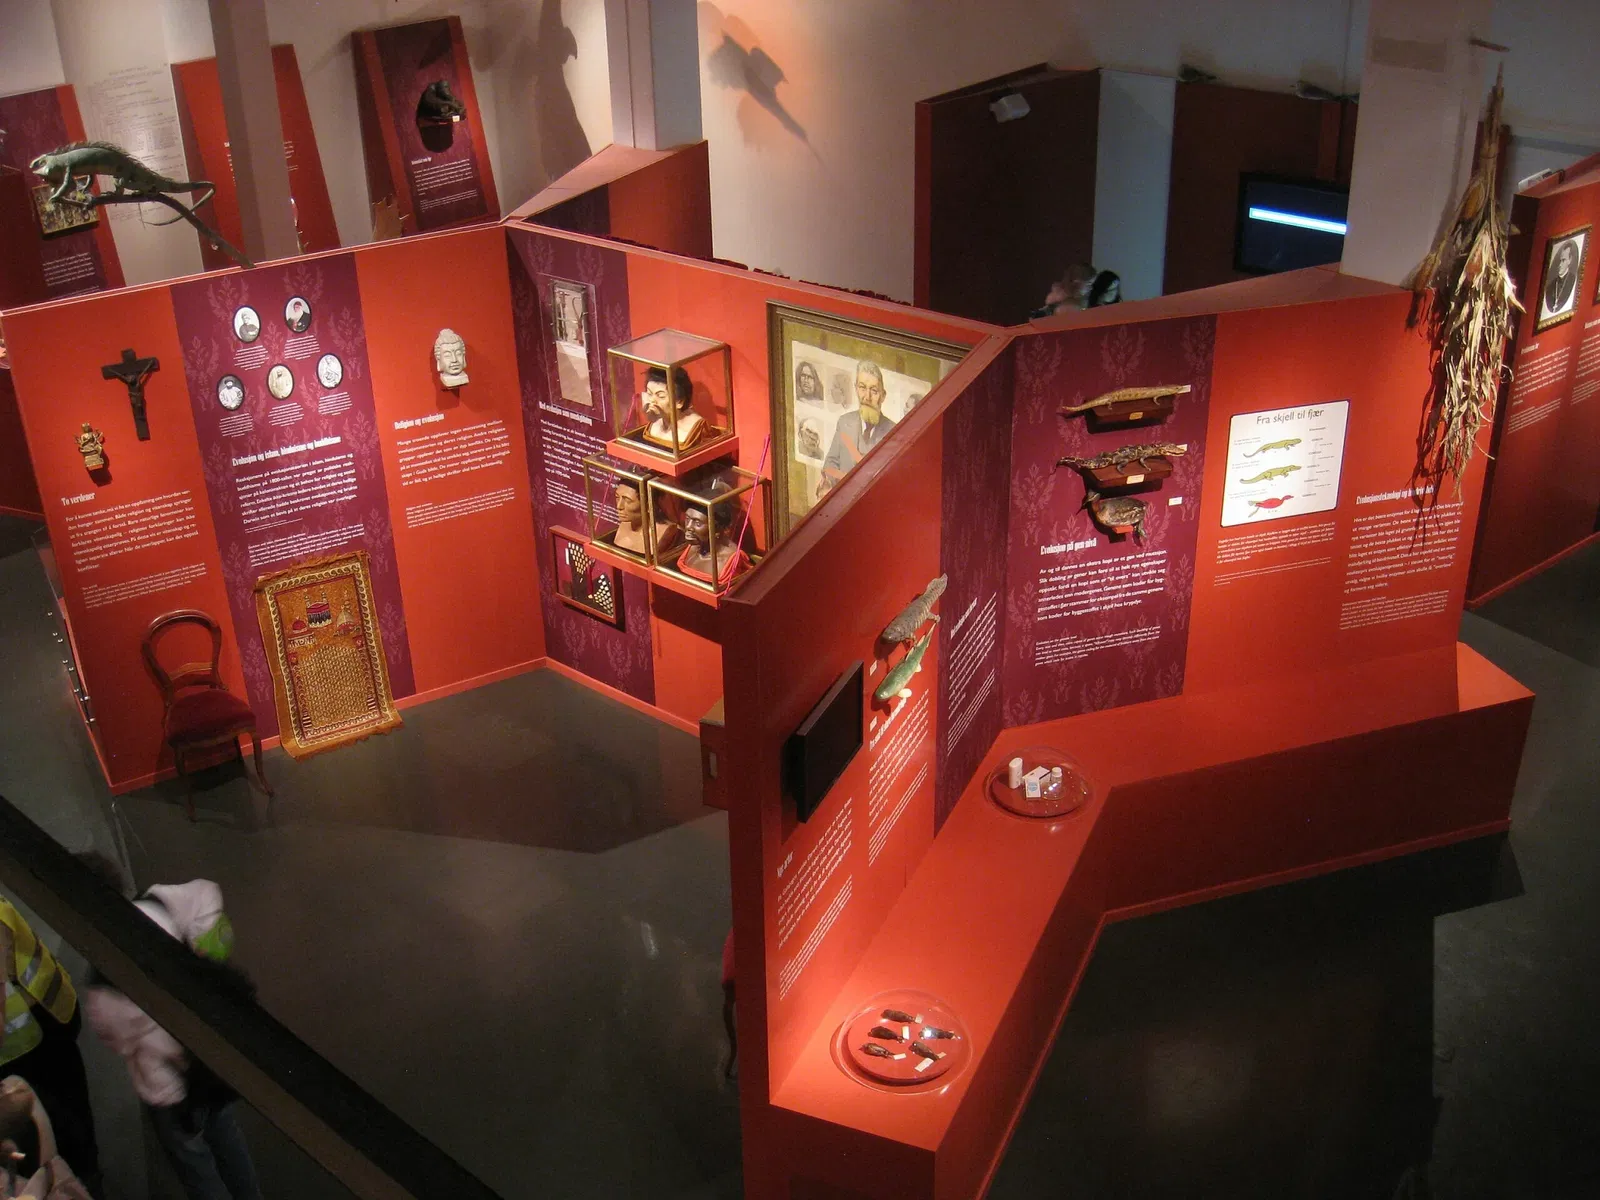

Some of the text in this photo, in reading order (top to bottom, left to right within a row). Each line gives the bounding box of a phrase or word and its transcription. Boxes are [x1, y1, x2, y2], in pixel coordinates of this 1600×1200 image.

[1257, 409, 1325, 425] Fra skjell til fjær
[1067, 541, 1074, 553] på
